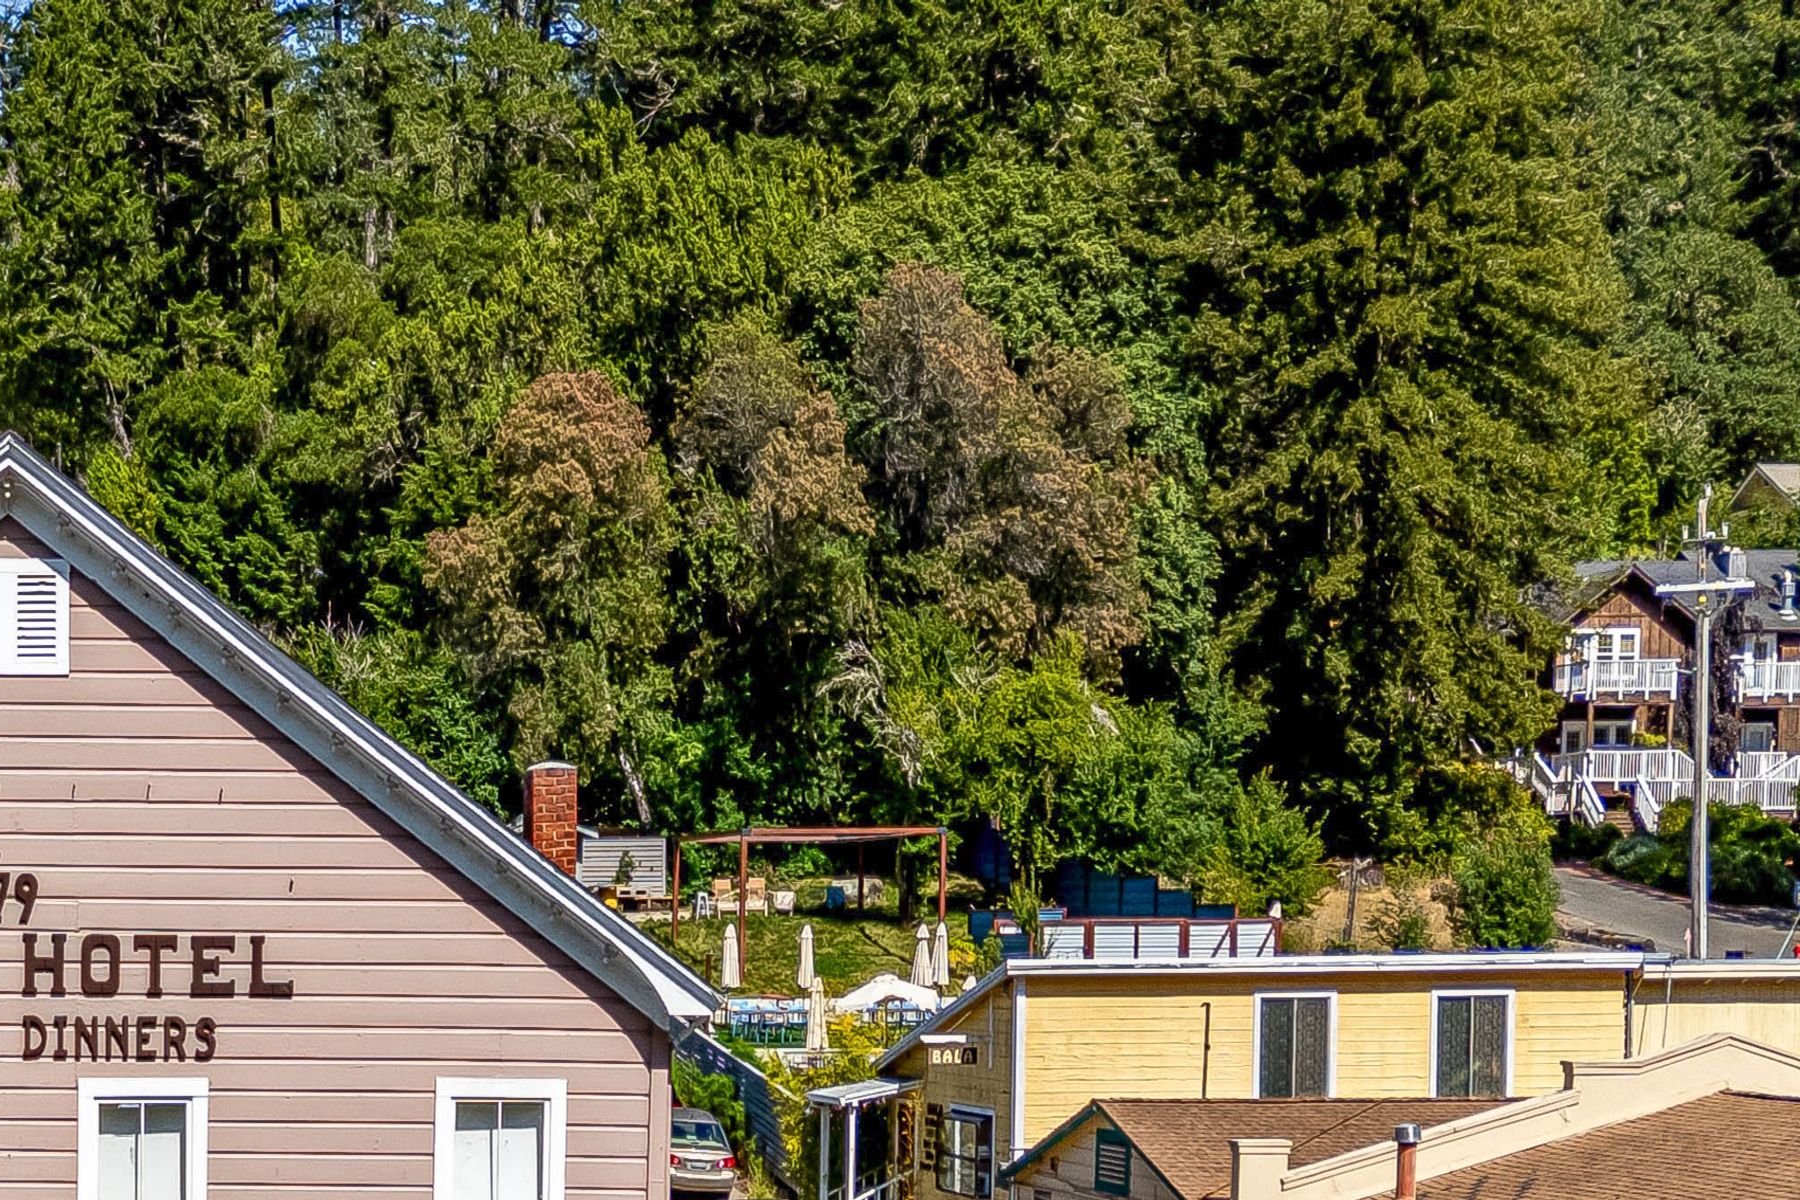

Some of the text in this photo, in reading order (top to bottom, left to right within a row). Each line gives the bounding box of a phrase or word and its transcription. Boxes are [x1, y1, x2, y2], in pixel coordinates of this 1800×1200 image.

[22, 933, 294, 999] HOTEL
[22, 1015, 217, 1062] DINNERS
[932, 1048, 973, 1064] BALA
